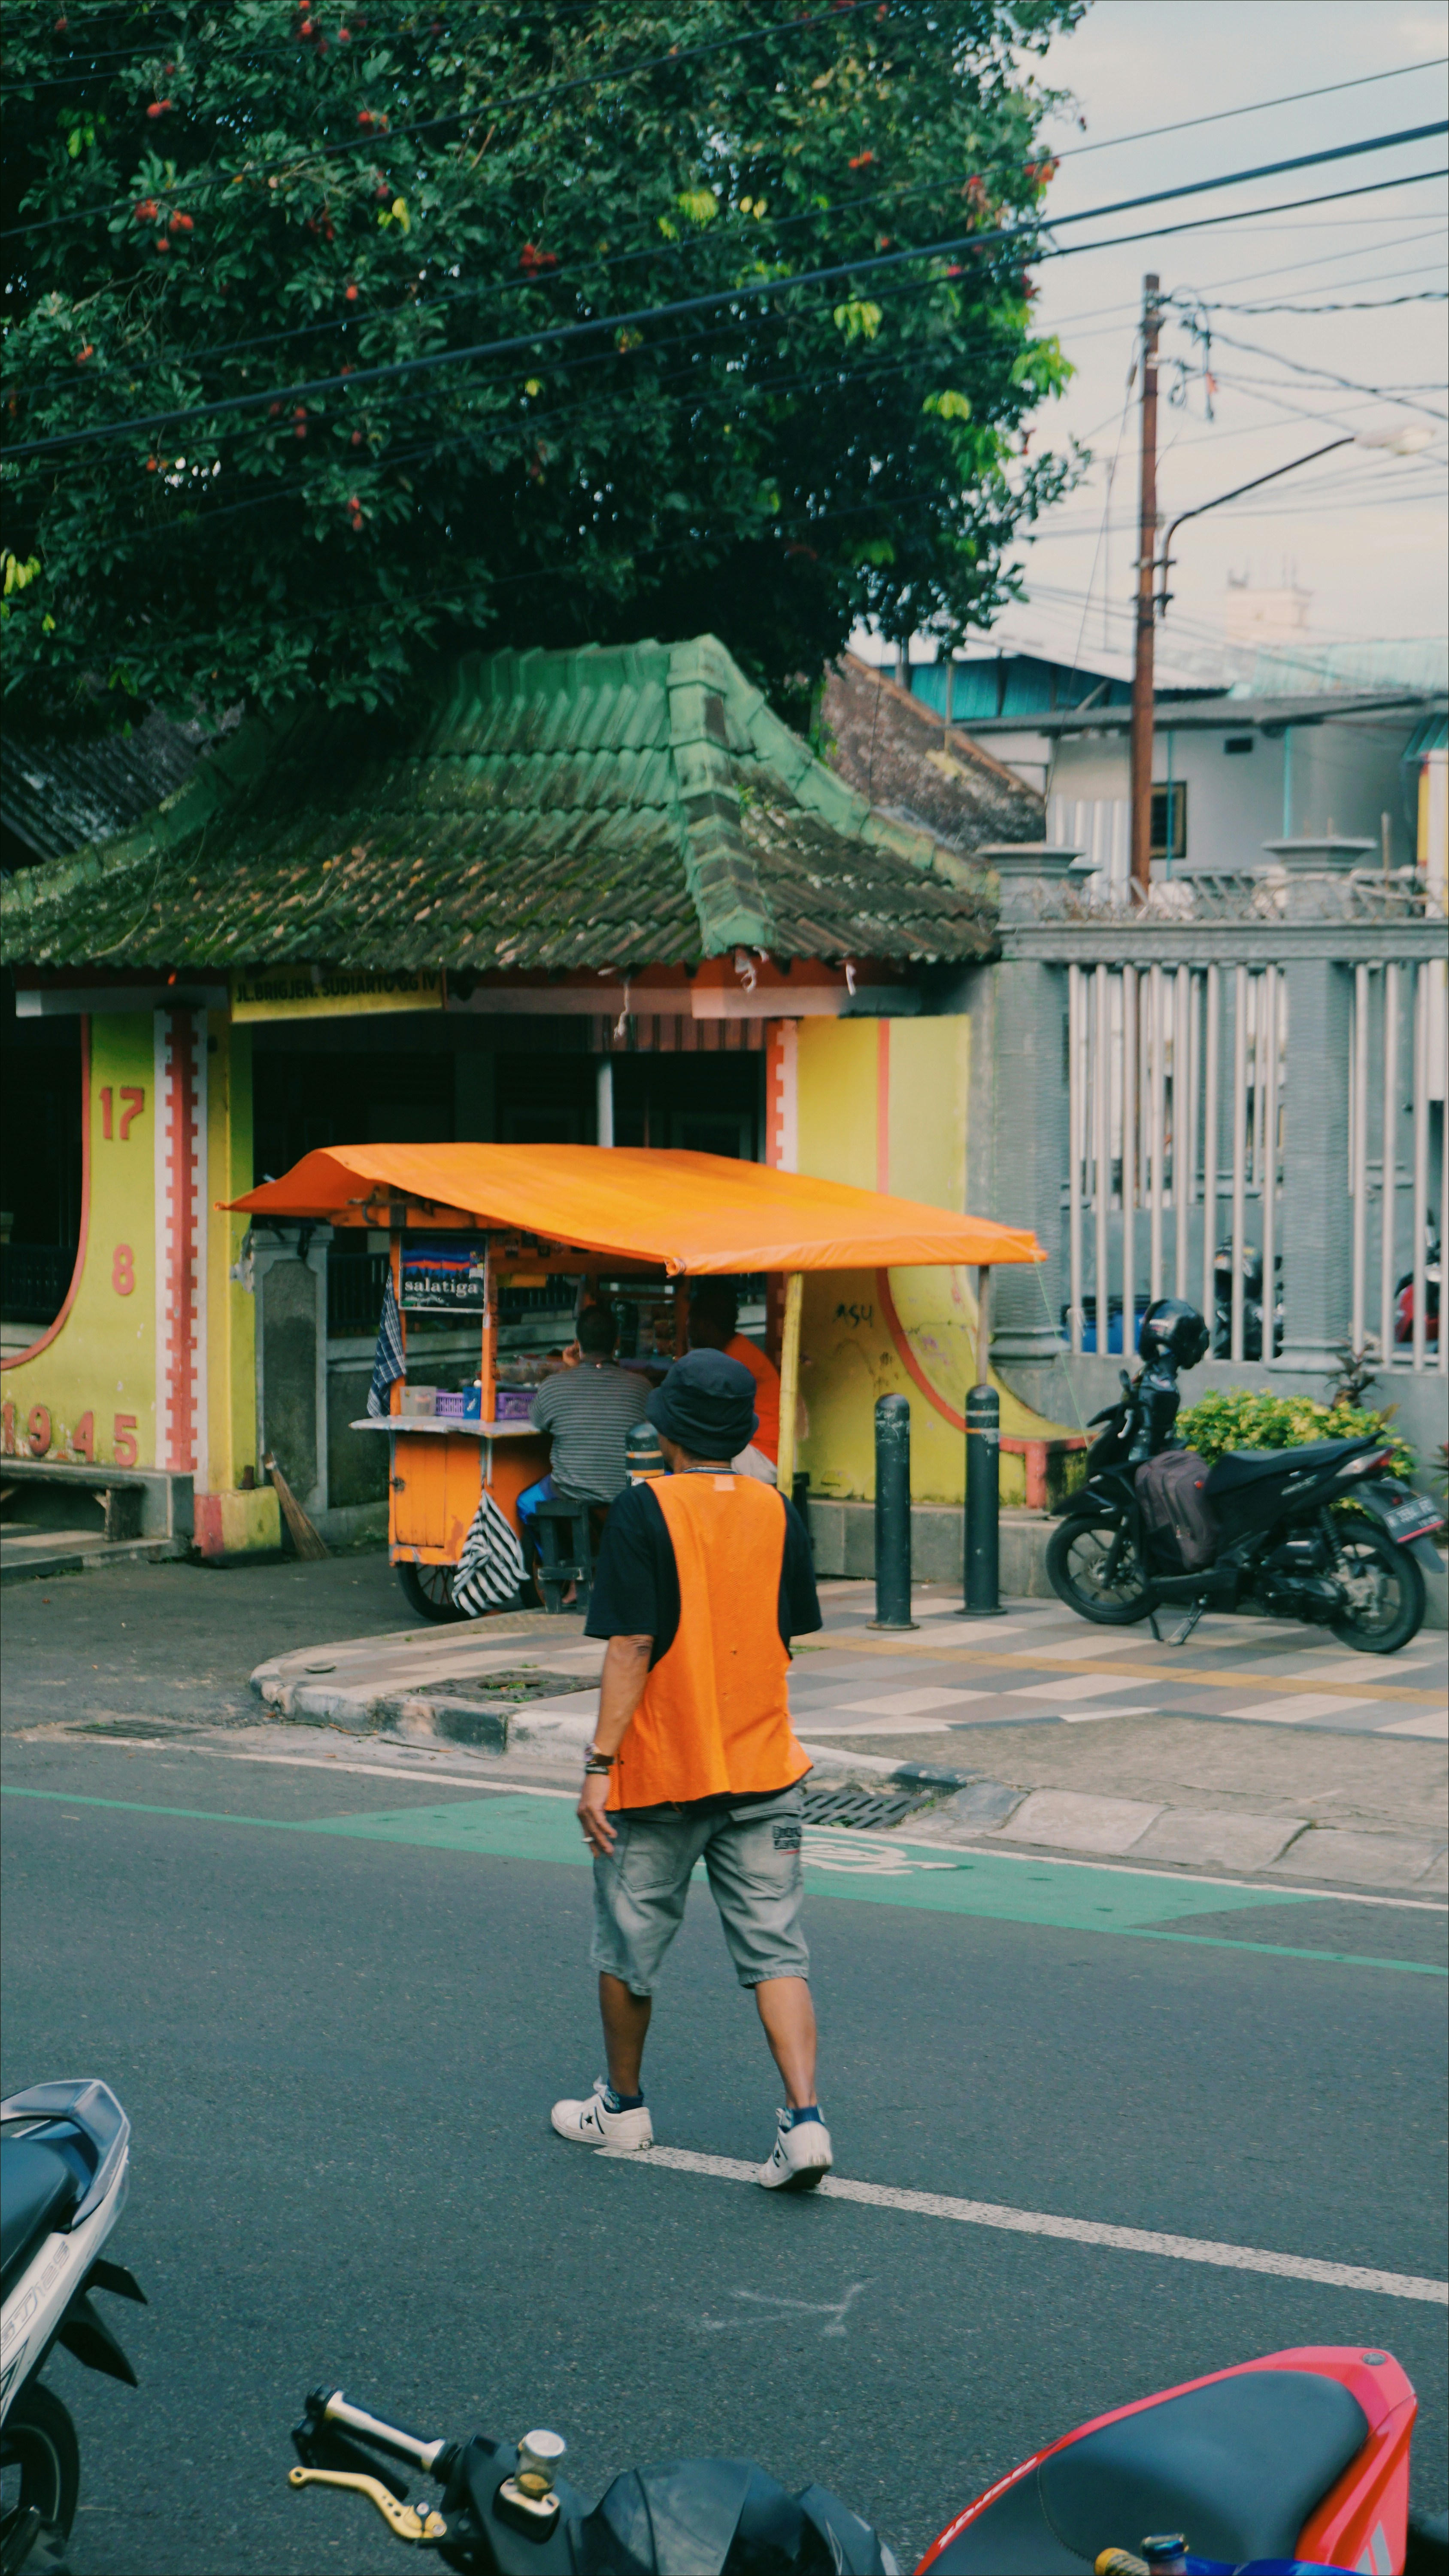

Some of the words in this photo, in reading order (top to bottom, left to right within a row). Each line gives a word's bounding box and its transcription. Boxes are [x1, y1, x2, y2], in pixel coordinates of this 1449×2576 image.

[321, 974, 394, 996] SUDIARTO
[100, 1086, 145, 1140] 17
[112, 1244, 134, 1295] 8
[405, 1276, 479, 1298] salatiga
